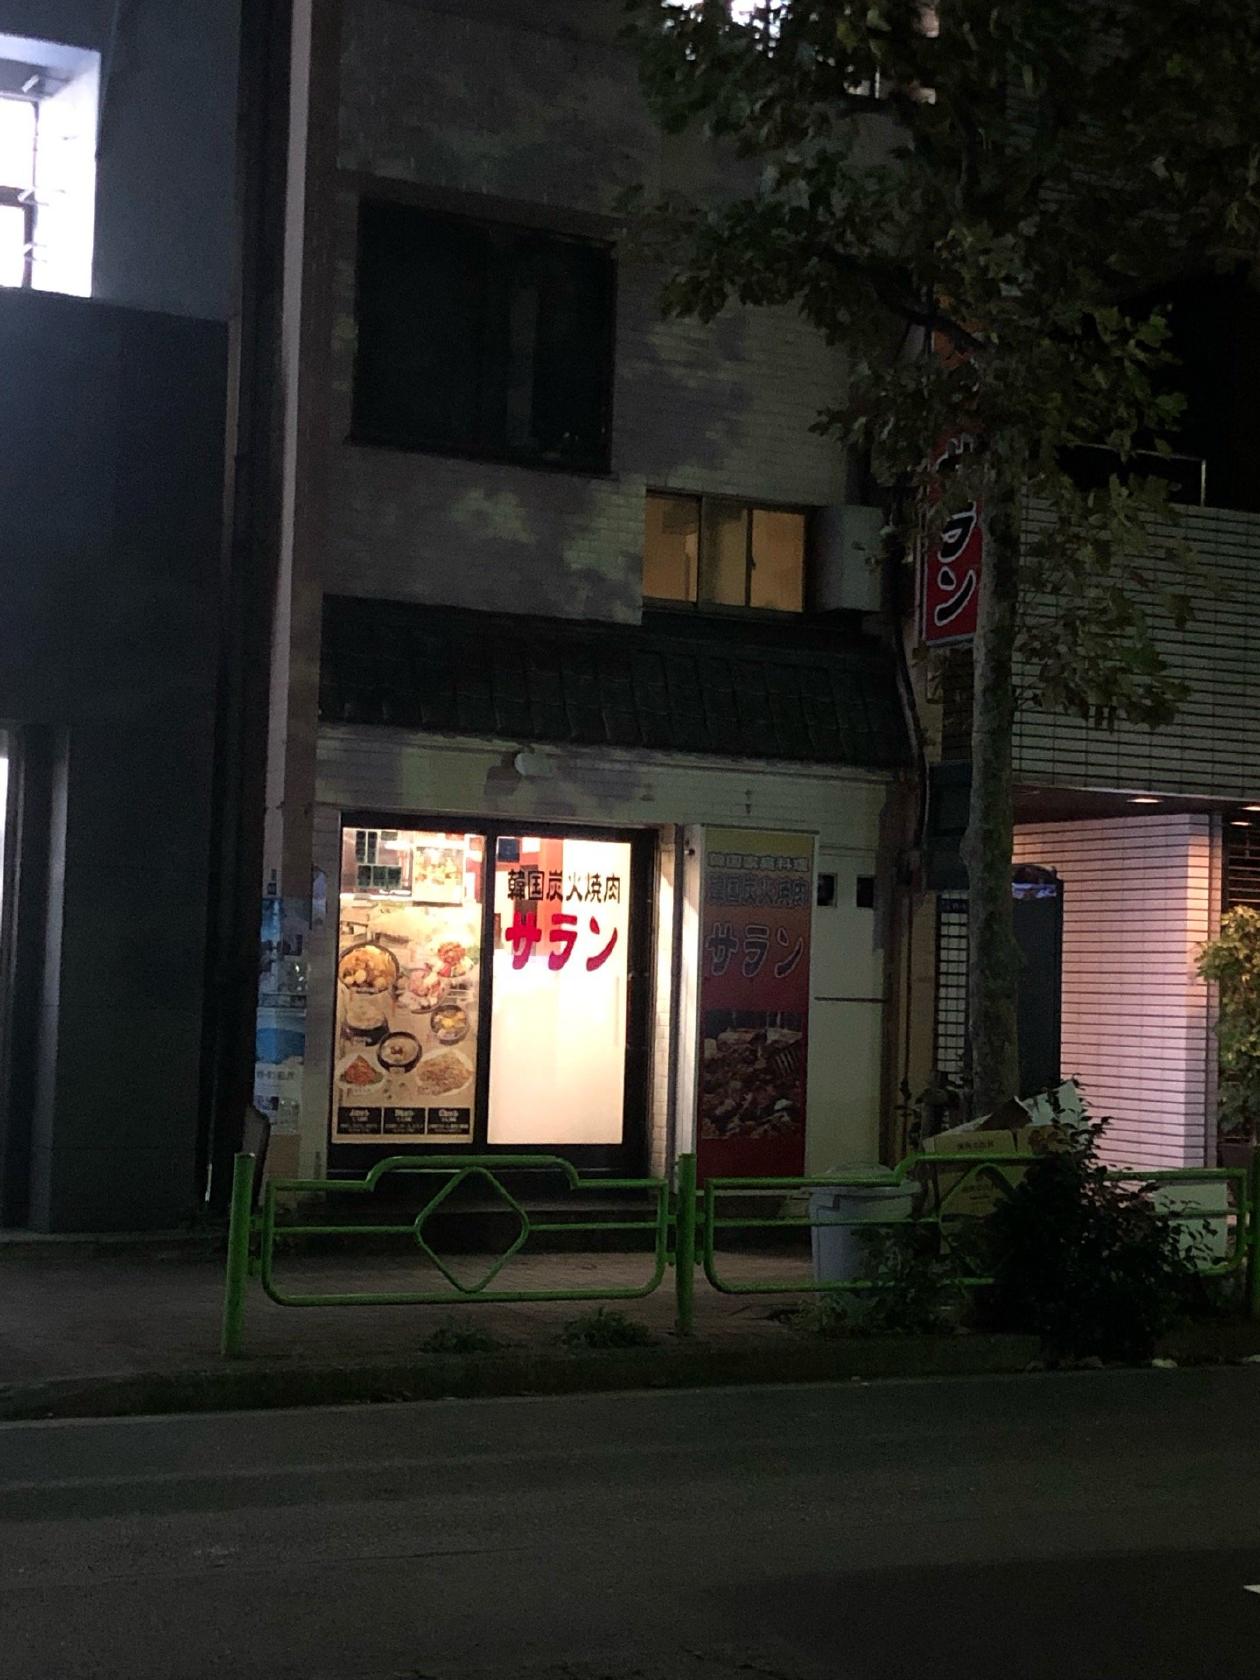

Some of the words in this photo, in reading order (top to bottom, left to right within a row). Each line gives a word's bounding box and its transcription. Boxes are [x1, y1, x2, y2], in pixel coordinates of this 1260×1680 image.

[508, 868, 620, 904] 韓国炭火焼肉
[505, 912, 618, 972] サラン
[704, 922, 803, 978] サラン
